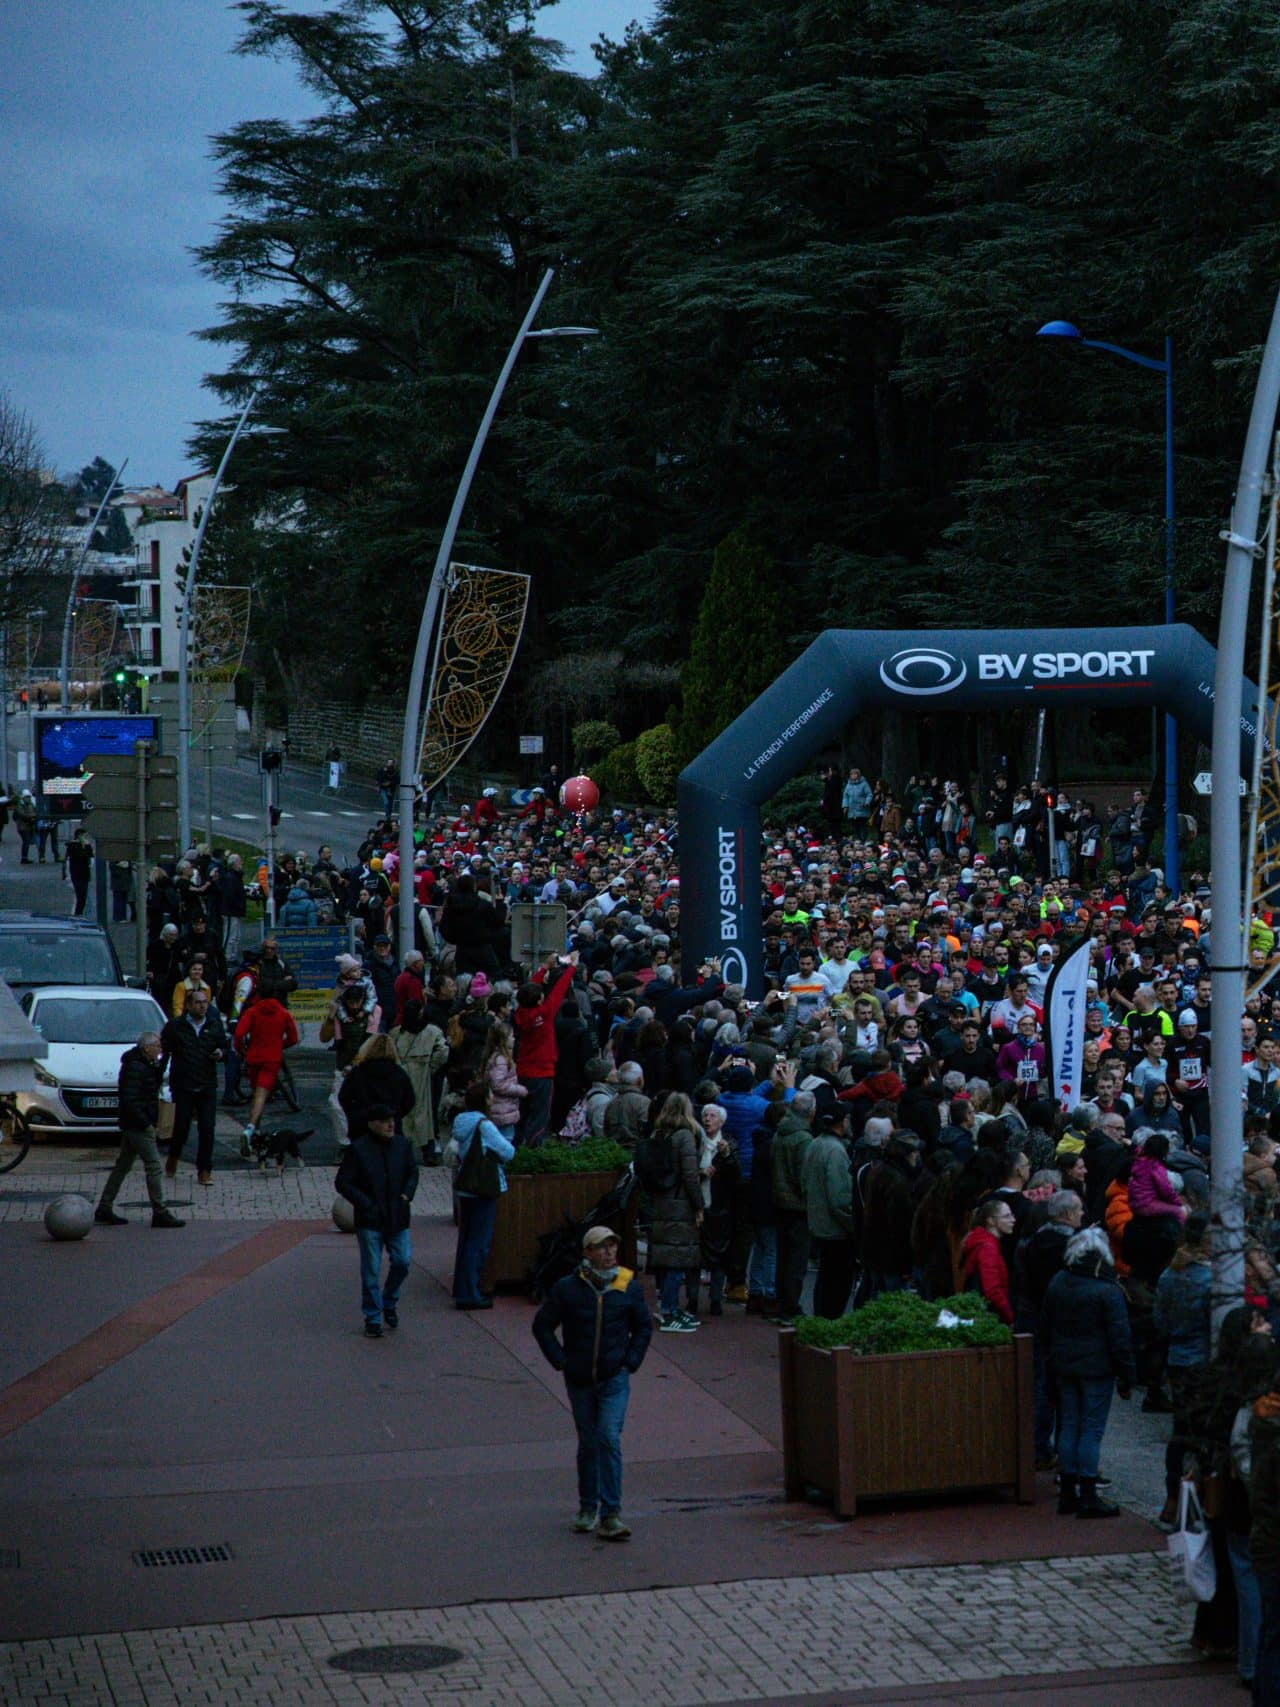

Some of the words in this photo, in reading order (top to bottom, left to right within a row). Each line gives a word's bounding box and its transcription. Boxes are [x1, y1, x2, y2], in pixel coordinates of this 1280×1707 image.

[978, 653, 1028, 680] BV
[1031, 650, 1155, 679] SPORT
[743, 767, 758, 780] LA
[753, 738, 785, 769] FRENCH
[781, 687, 834, 741] PERFORMANCE
[718, 826, 736, 906] SPORT
[720, 908, 738, 940] BV
